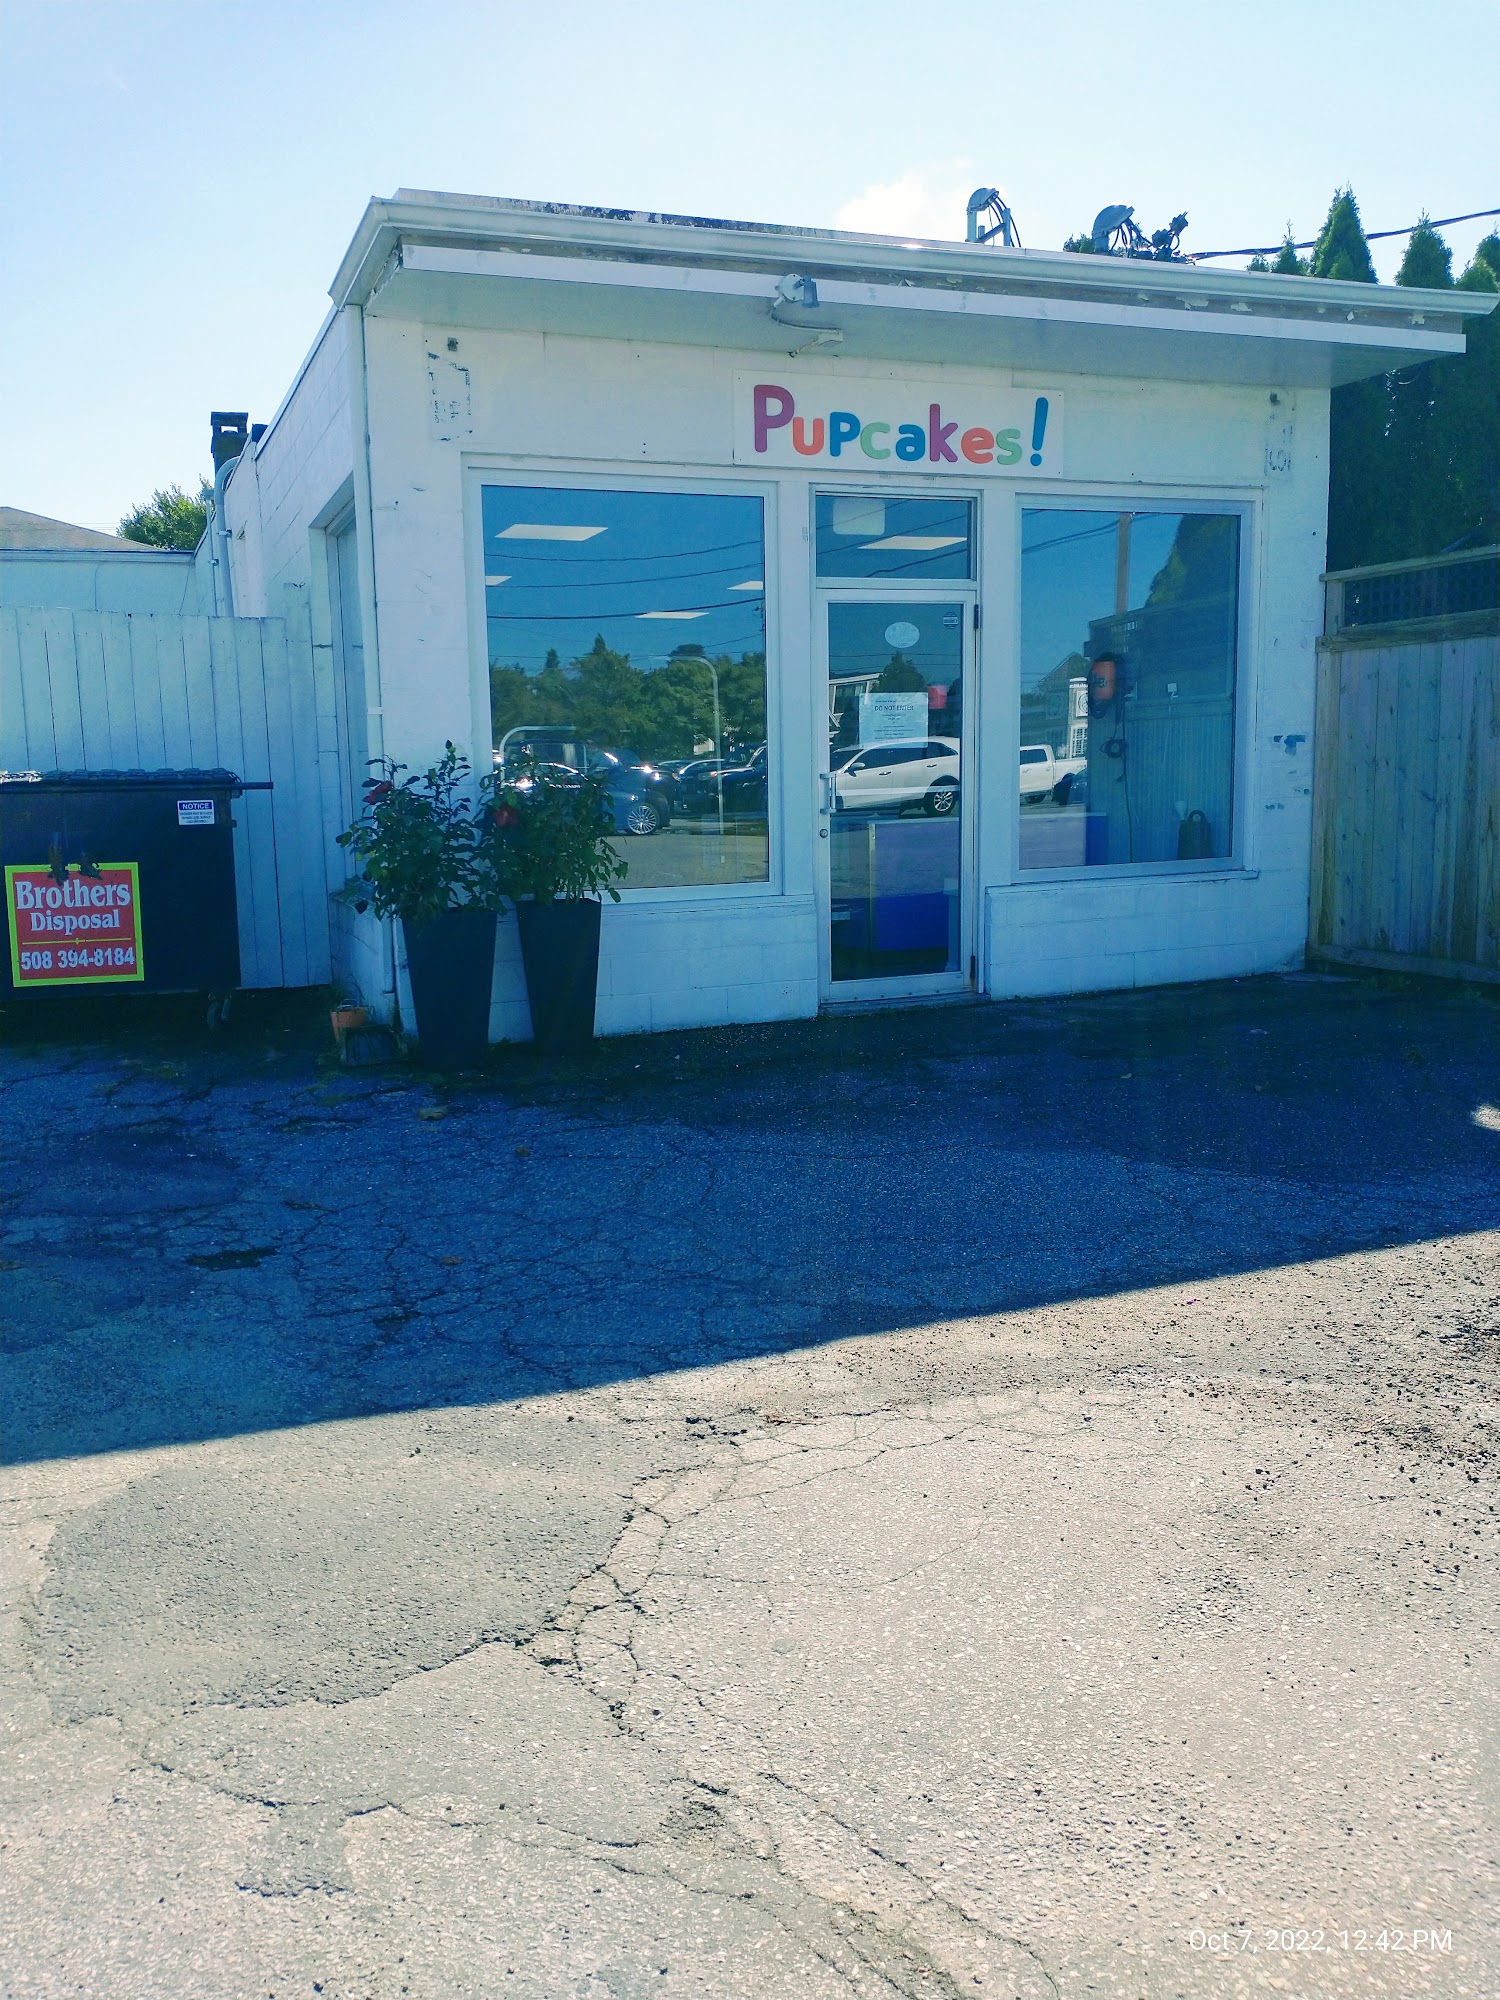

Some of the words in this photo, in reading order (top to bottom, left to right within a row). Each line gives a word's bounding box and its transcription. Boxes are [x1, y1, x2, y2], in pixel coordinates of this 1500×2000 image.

[15, 879, 131, 909] Brothers
[30, 909, 120, 935] Disposal
[21, 951, 52, 970] 508
[57, 947, 135, 968] 394-8184
